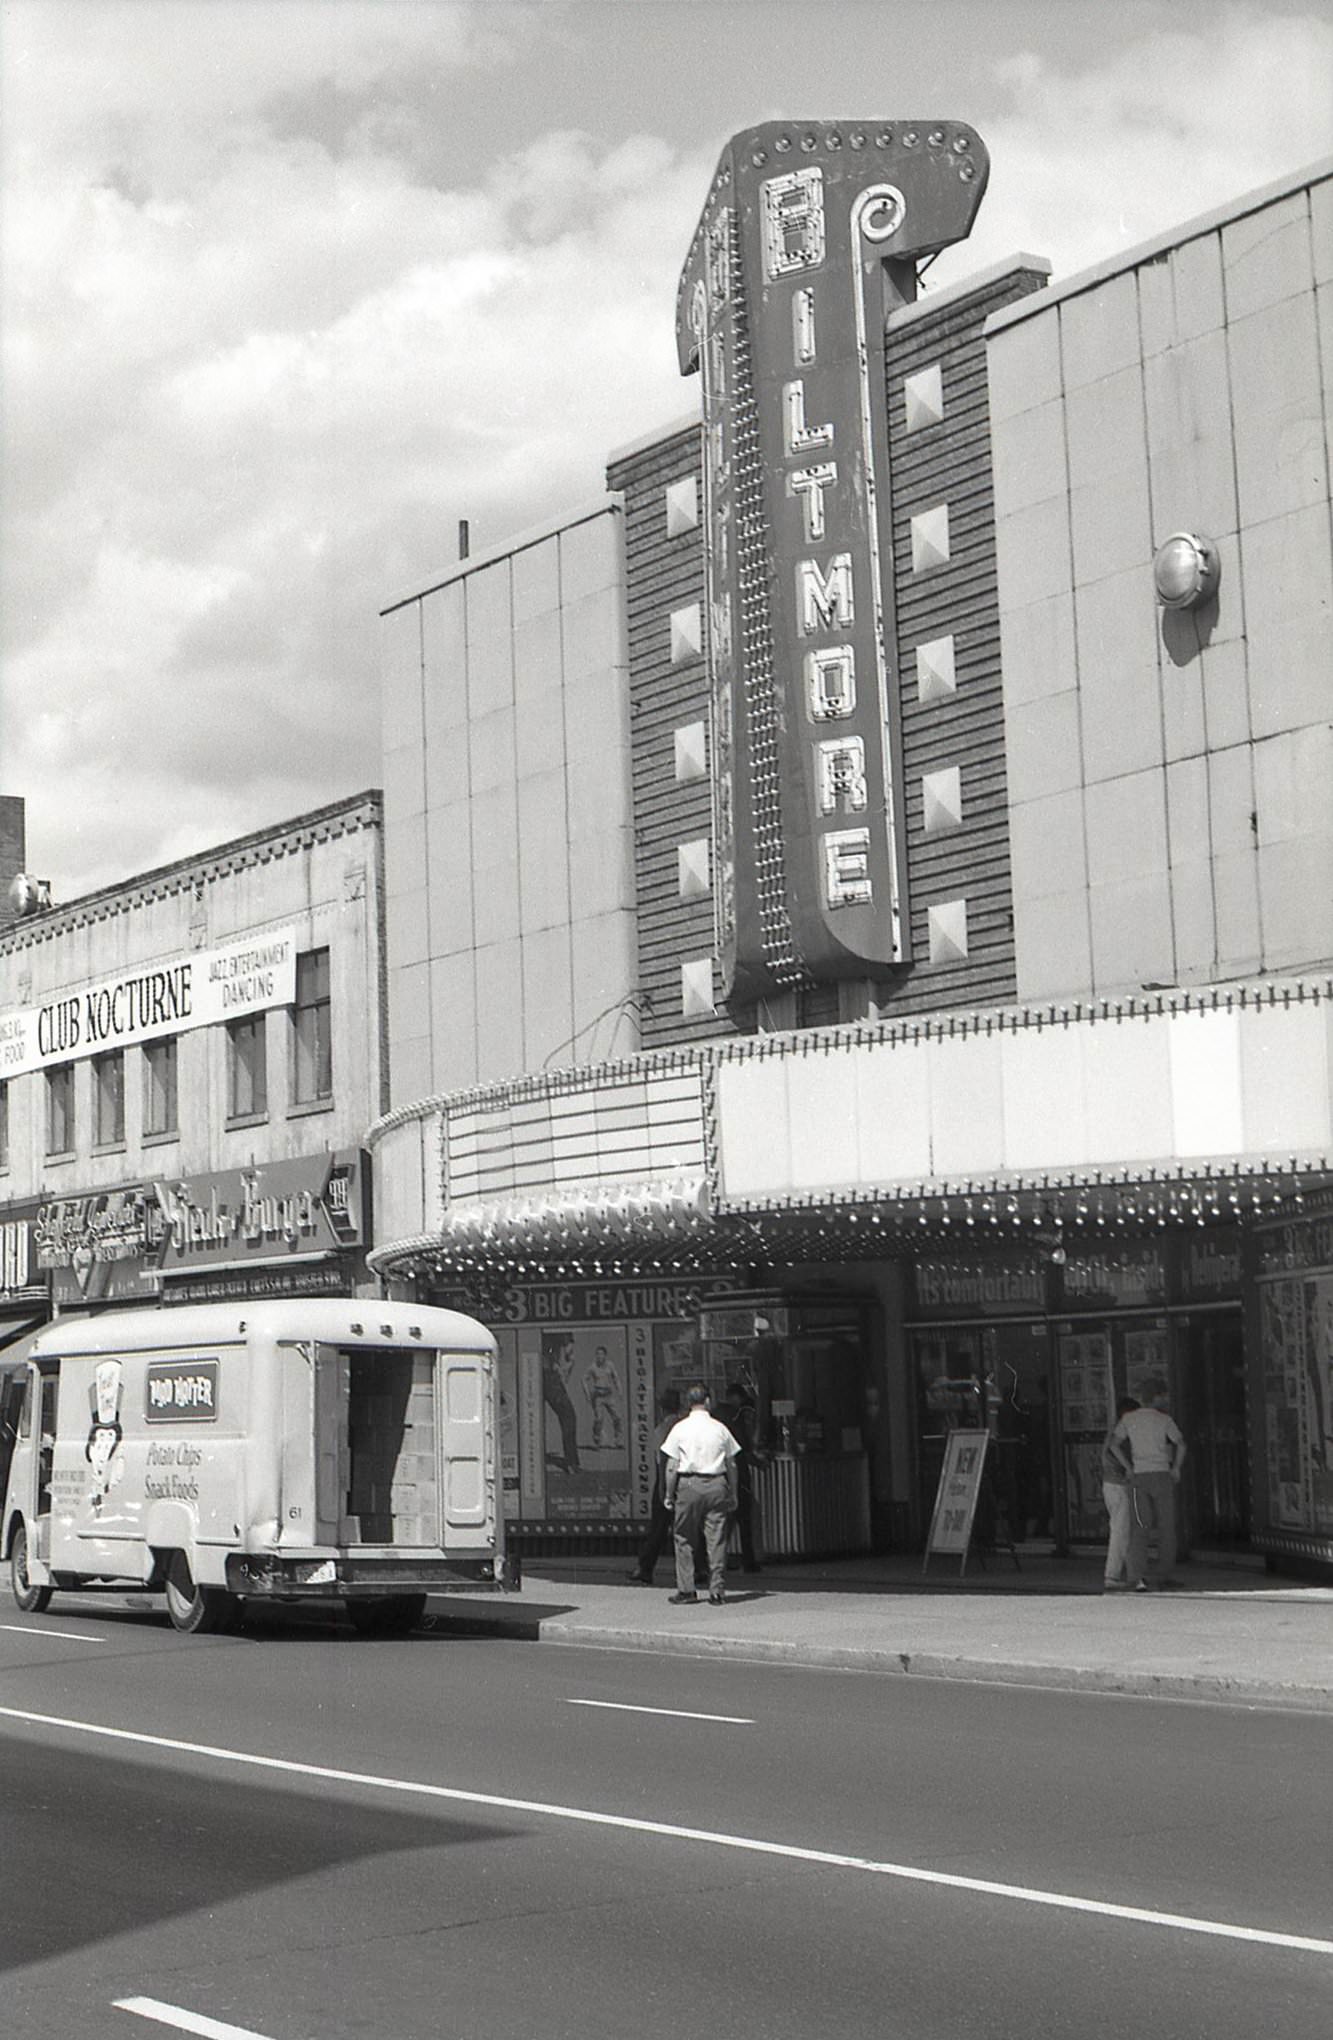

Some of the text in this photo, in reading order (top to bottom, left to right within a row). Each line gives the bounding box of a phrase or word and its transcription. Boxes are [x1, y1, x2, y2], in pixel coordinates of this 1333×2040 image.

[760, 165, 873, 910] BILTMORE
[222, 971, 273, 1009] DANCING
[38, 997, 80, 1057] CLUB
[86, 964, 192, 1043] NOCTURNE
[503, 1288, 529, 1322] 3
[534, 1292, 574, 1318] BIG
[584, 1285, 701, 1317] FEATURES
[635, 1383, 650, 1494] ATTRACTIONS
[146, 1442, 202, 1473] Potato Chips
[144, 1474, 200, 1501] Snack Foods
[288, 1506, 302, 1520] 61
